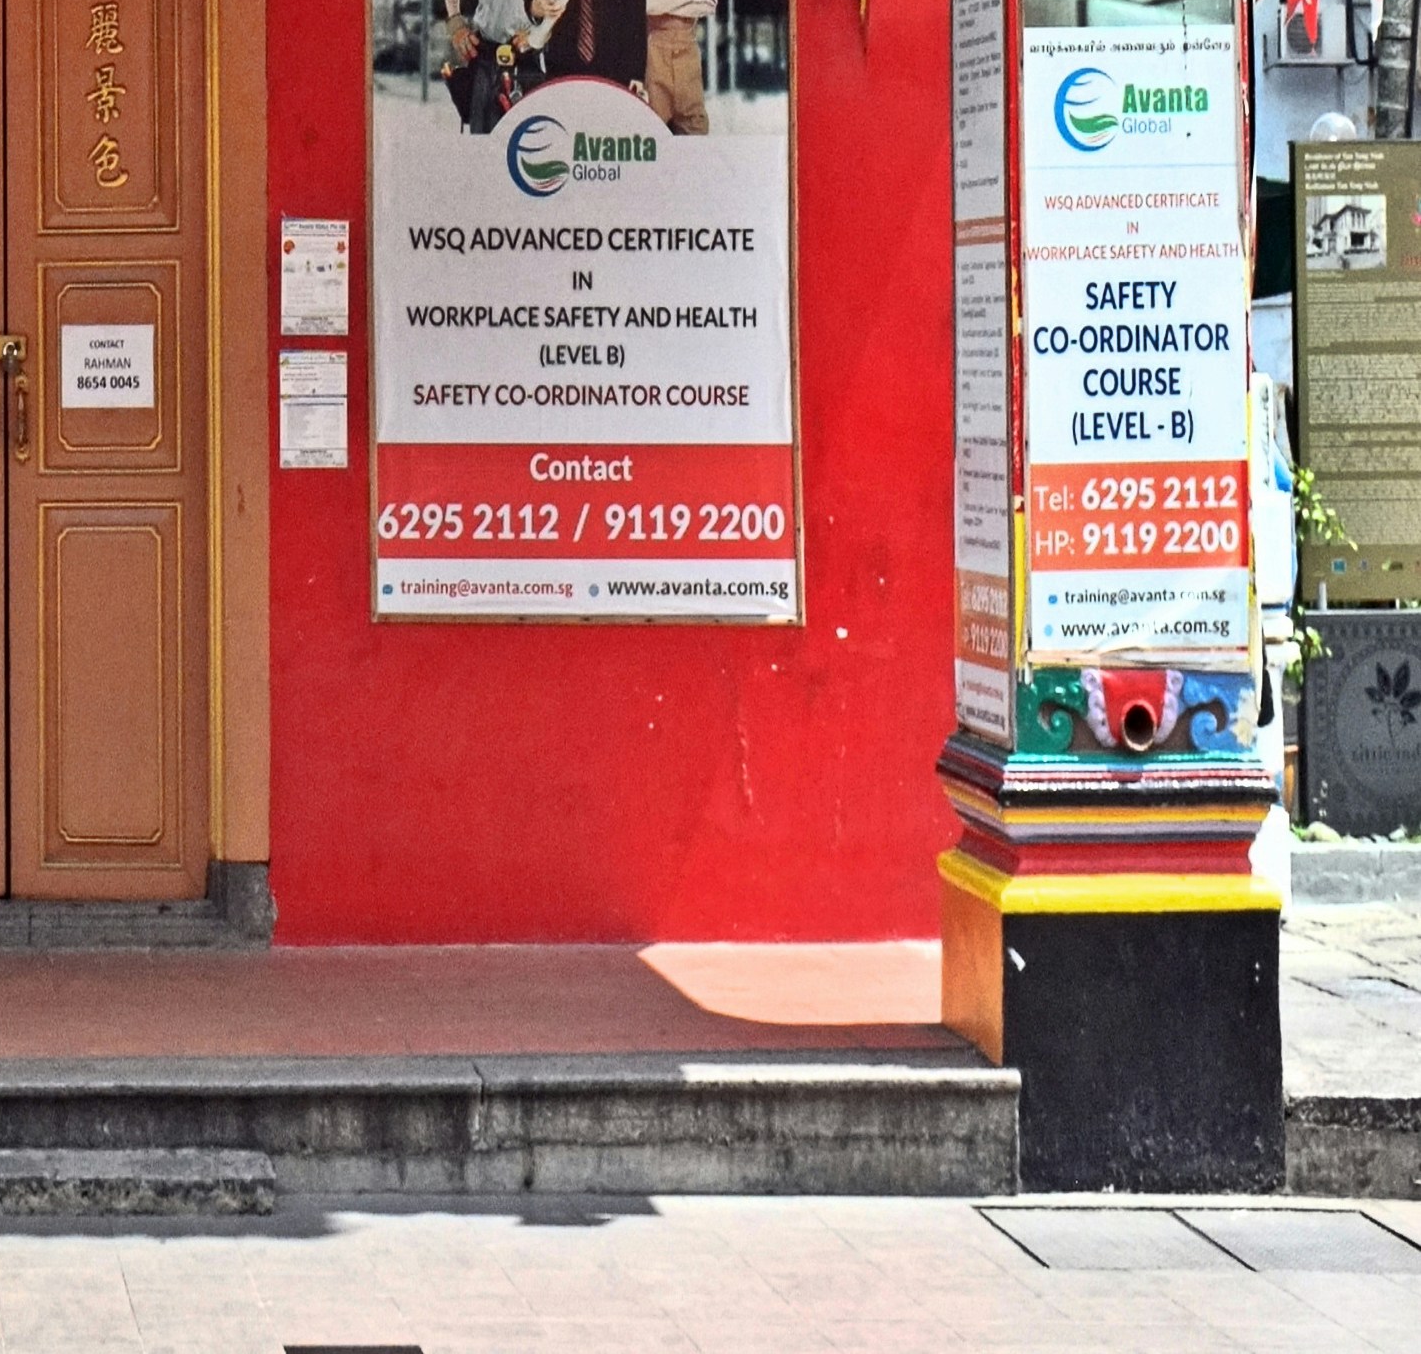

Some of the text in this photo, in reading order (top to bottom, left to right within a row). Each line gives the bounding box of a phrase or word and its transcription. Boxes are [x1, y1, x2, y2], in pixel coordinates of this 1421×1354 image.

[1122, 84, 1208, 113] Avanta
[1122, 117, 1171, 134] Global
[573, 131, 657, 161] Avanta
[573, 164, 621, 181] Global
[1045, 193, 1219, 211] WSQ ADVANCED CERTIFICATE
[1127, 222, 1139, 233] IN
[409, 227, 754, 254] WSQ ADVANCED CERTIFICATE
[1026, 243, 1239, 260] WORKPLACE SAFETY AND HEALTH
[573, 272, 592, 289] IN
[1086, 281, 1176, 310] SAFETY
[407, 306, 756, 327] WORKPLACE SAFETY AND HEALTH
[89, 340, 124, 348] CONTACT
[1034, 324, 1229, 354] CO-ORDINATOR
[84, 358, 131, 369] RAHMAN
[540, 345, 601, 367] (LEVEL
[77, 376, 139, 388] 8654 0045
[1083, 368, 1180, 396] COURSE
[414, 384, 748, 406] SAFETY CO-ORDINATOR COURSE
[1072, 412, 1151, 446] (LEVEL
[530, 453, 632, 481] Contact
[1034, 476, 1238, 510] Tel: 6295 2112
[379, 504, 463, 539] 6295
[473, 504, 558, 539] 2112
[606, 504, 690, 539] 9119
[699, 504, 784, 540] 2200
[1036, 521, 1239, 554] HP: 9119 2200
[400, 579, 573, 598] training@avanta.com.sg
[608, 579, 788, 599] www.avanta.com.sg
